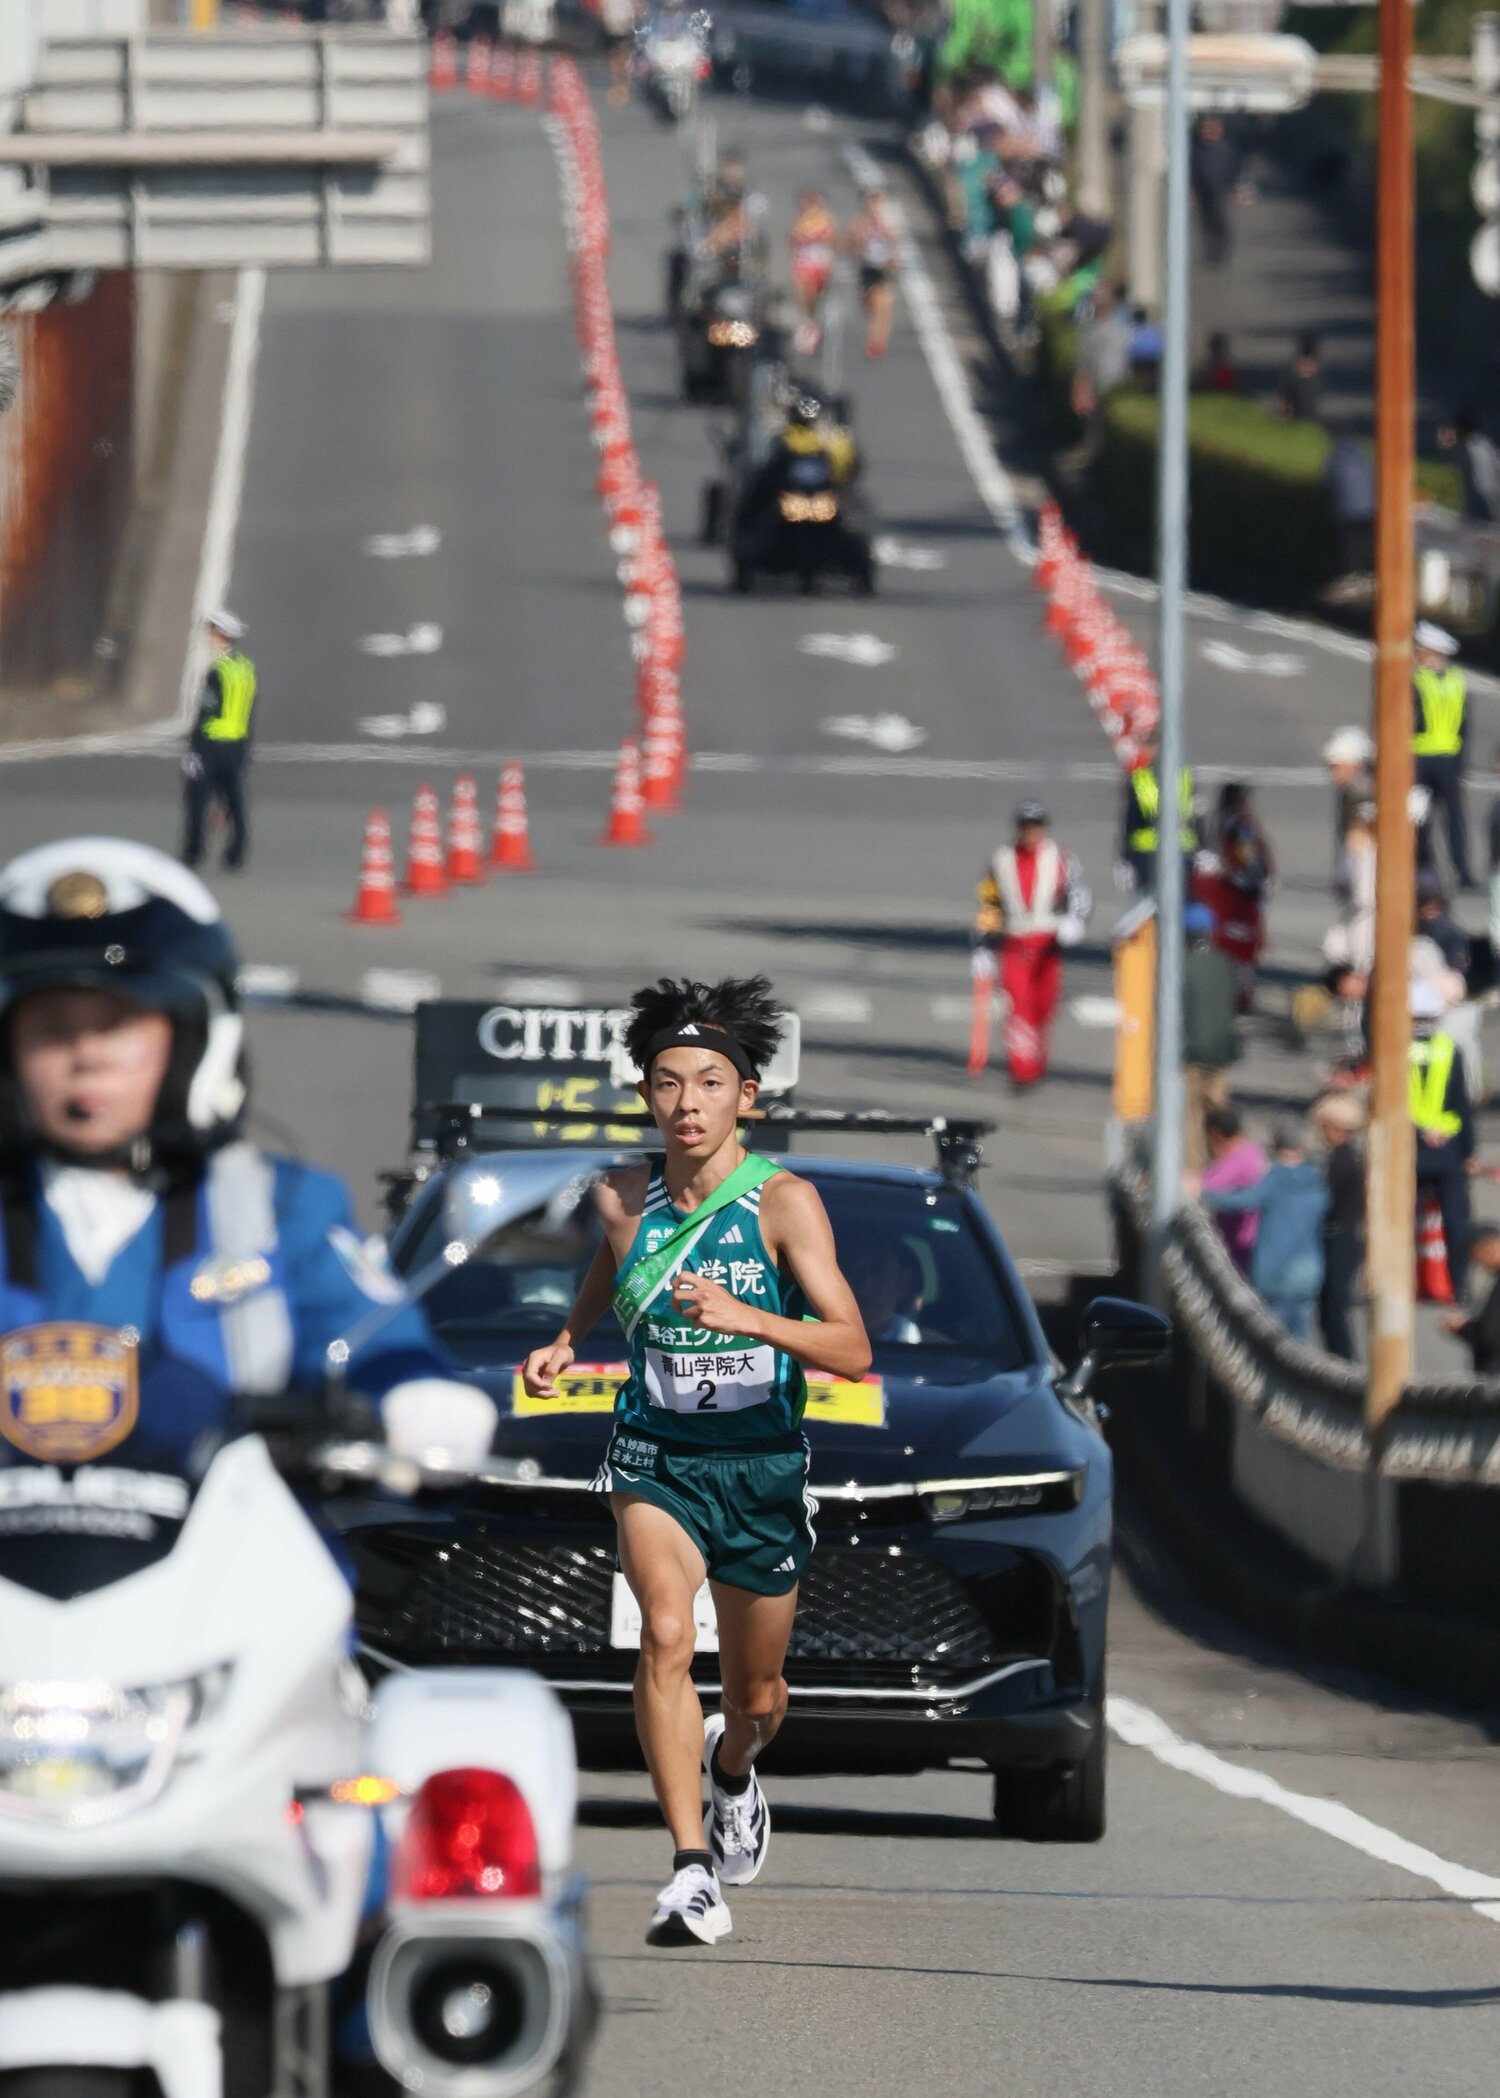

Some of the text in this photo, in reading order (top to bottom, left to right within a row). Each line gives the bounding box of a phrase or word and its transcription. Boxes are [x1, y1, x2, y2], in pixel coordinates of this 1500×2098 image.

[661, 1353, 755, 1378] 青山学院大
[696, 1379, 718, 1410] 2
[627, 1438, 659, 1456] 妙高市
[621, 1452, 655, 1469] 水上村
